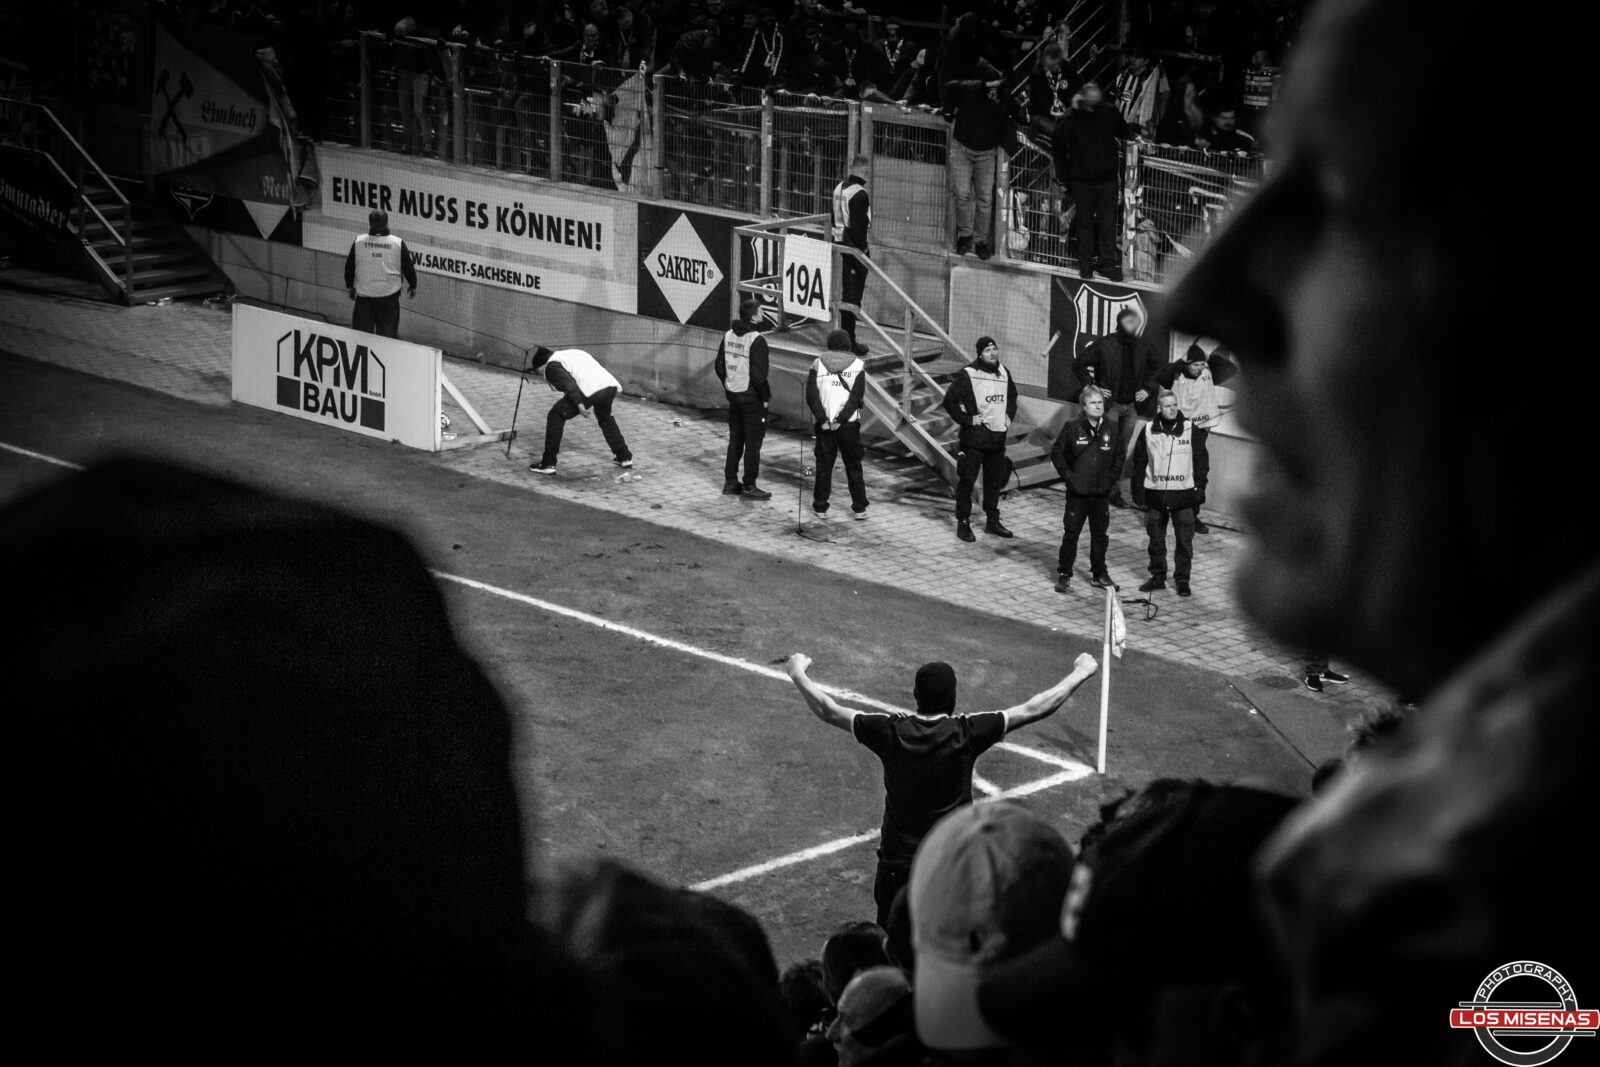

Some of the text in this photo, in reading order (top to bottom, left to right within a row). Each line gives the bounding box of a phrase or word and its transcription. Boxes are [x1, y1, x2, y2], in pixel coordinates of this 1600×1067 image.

[201, 100, 256, 131] Limbach
[332, 176, 602, 252] EINER MUSS ES KÖNNEN!
[409, 250, 541, 290] W.SAKRET-SACHSEN.DE
[785, 262, 826, 311] 19A
[294, 329, 368, 395] KPM
[303, 382, 358, 424] BAU
